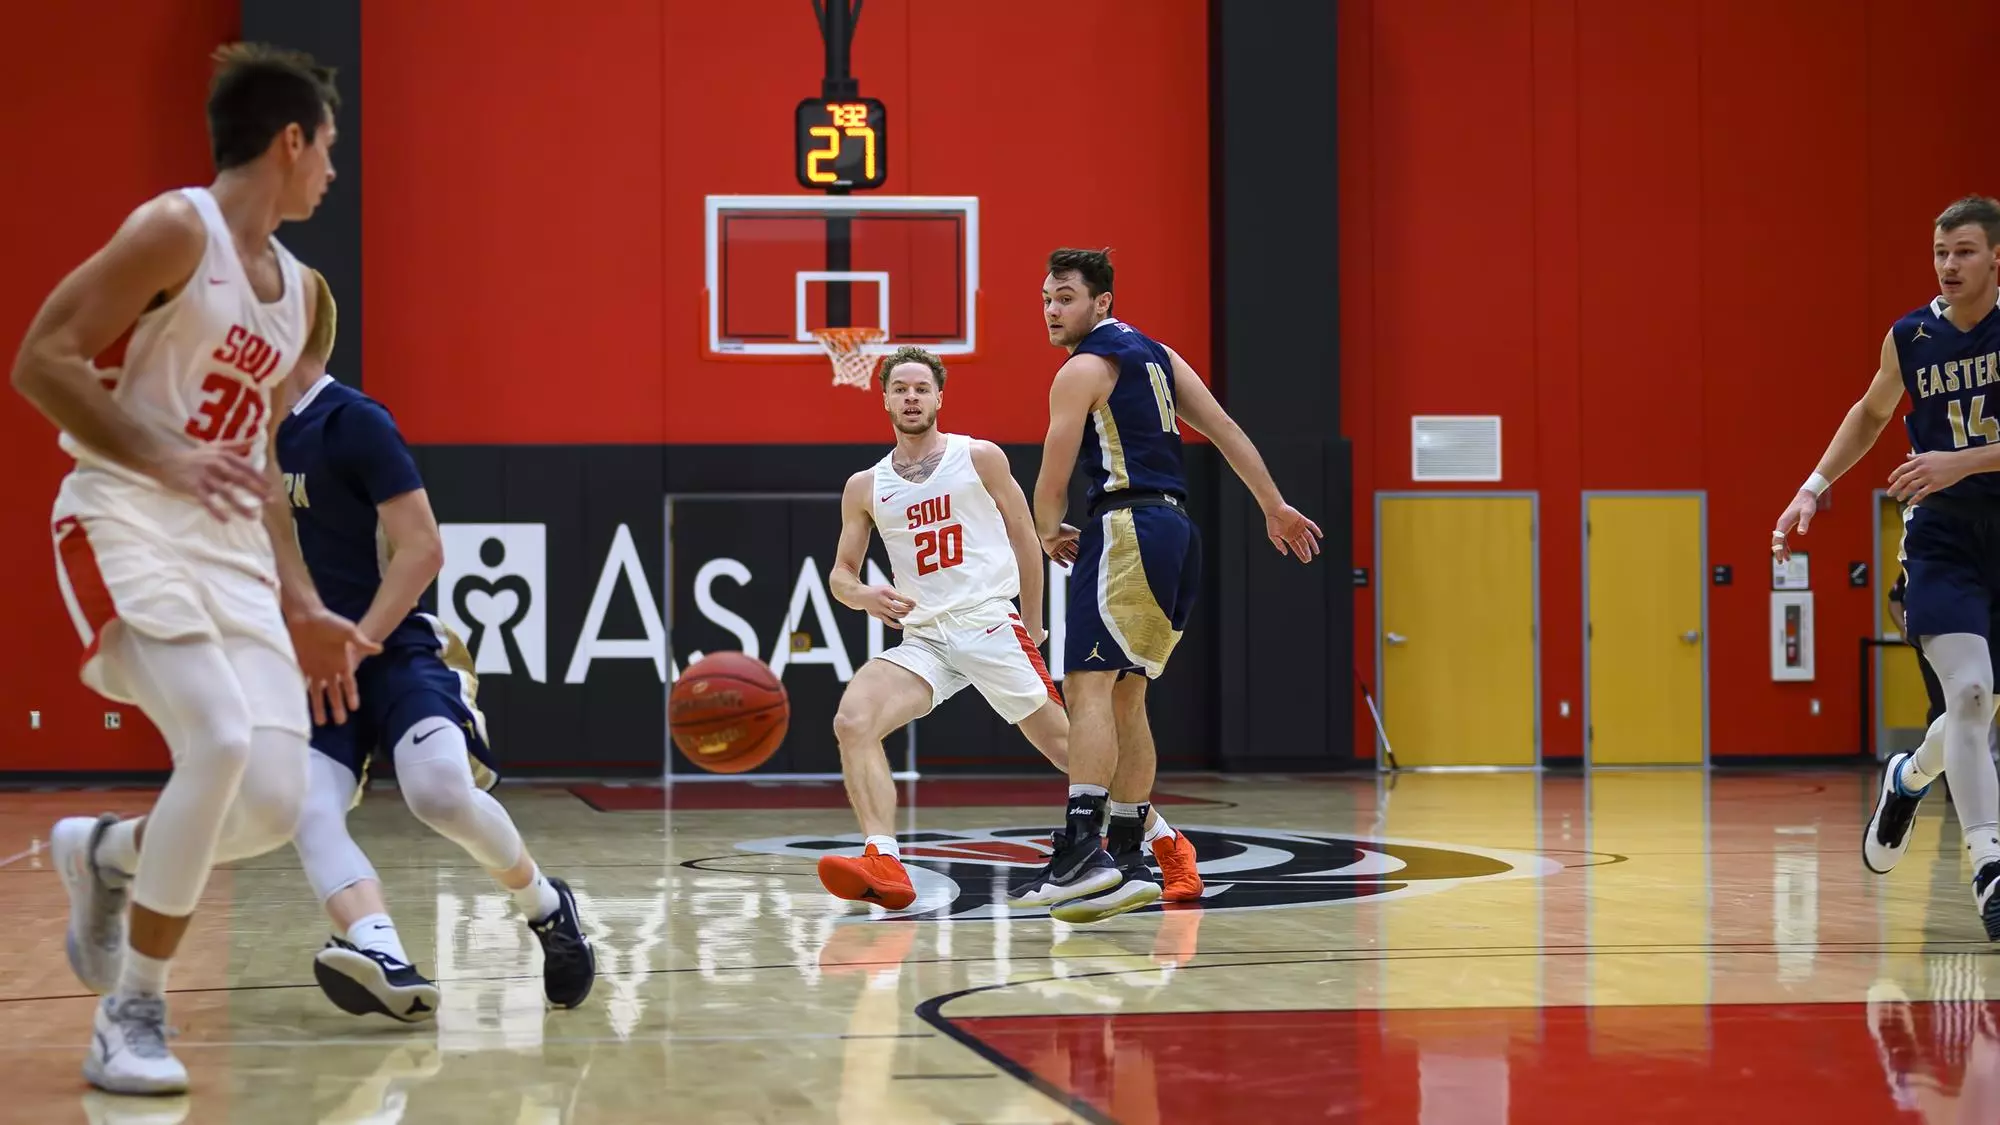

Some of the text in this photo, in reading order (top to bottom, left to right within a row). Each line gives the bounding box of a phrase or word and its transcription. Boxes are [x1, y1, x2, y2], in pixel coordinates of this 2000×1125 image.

[826, 103, 867, 127] 7:32
[807, 126, 875, 182] 27
[1916, 351, 2000, 399] EASTER
[184, 371, 265, 457] 30
[1947, 394, 2000, 449] 14
[906, 494, 951, 530] SOU
[914, 523, 964, 576] 20
